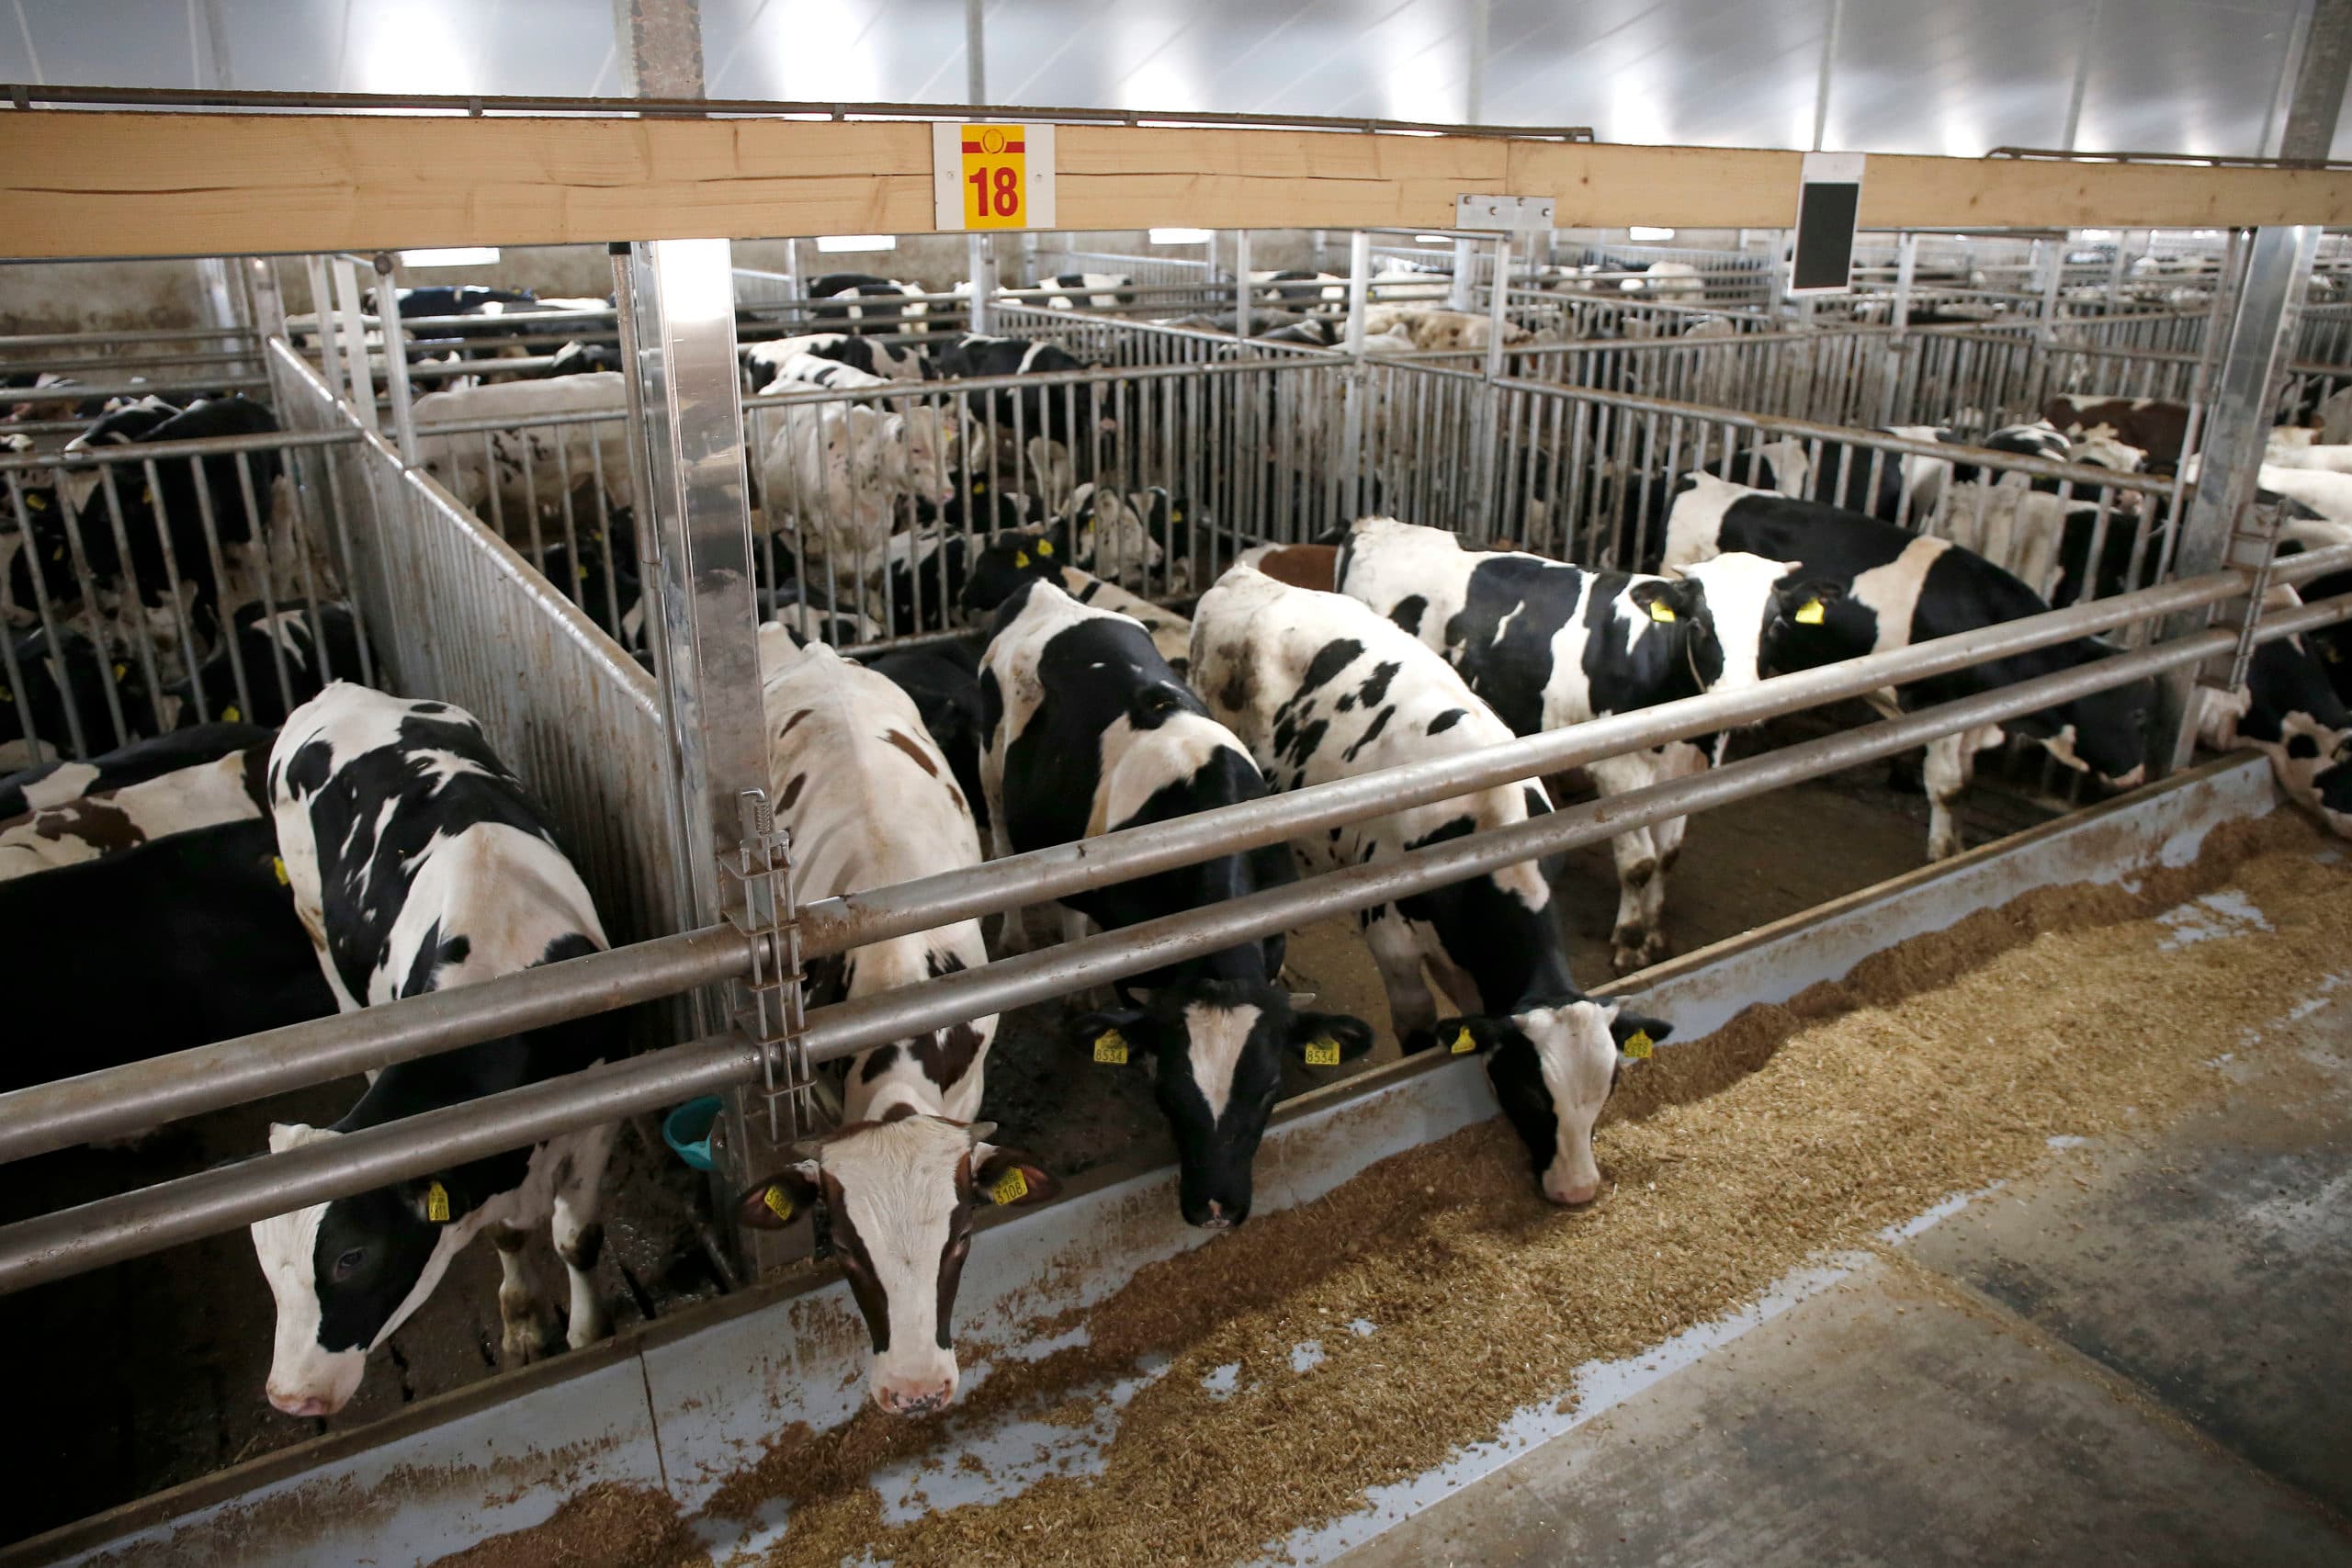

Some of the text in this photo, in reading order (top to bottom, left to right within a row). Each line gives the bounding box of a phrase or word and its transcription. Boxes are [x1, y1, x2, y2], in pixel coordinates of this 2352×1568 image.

[969, 167, 1018, 217] 18
[1096, 1049, 1123, 1062] 8534
[1307, 1050, 1334, 1064] 8534
[995, 1181, 1023, 1204] 3108
